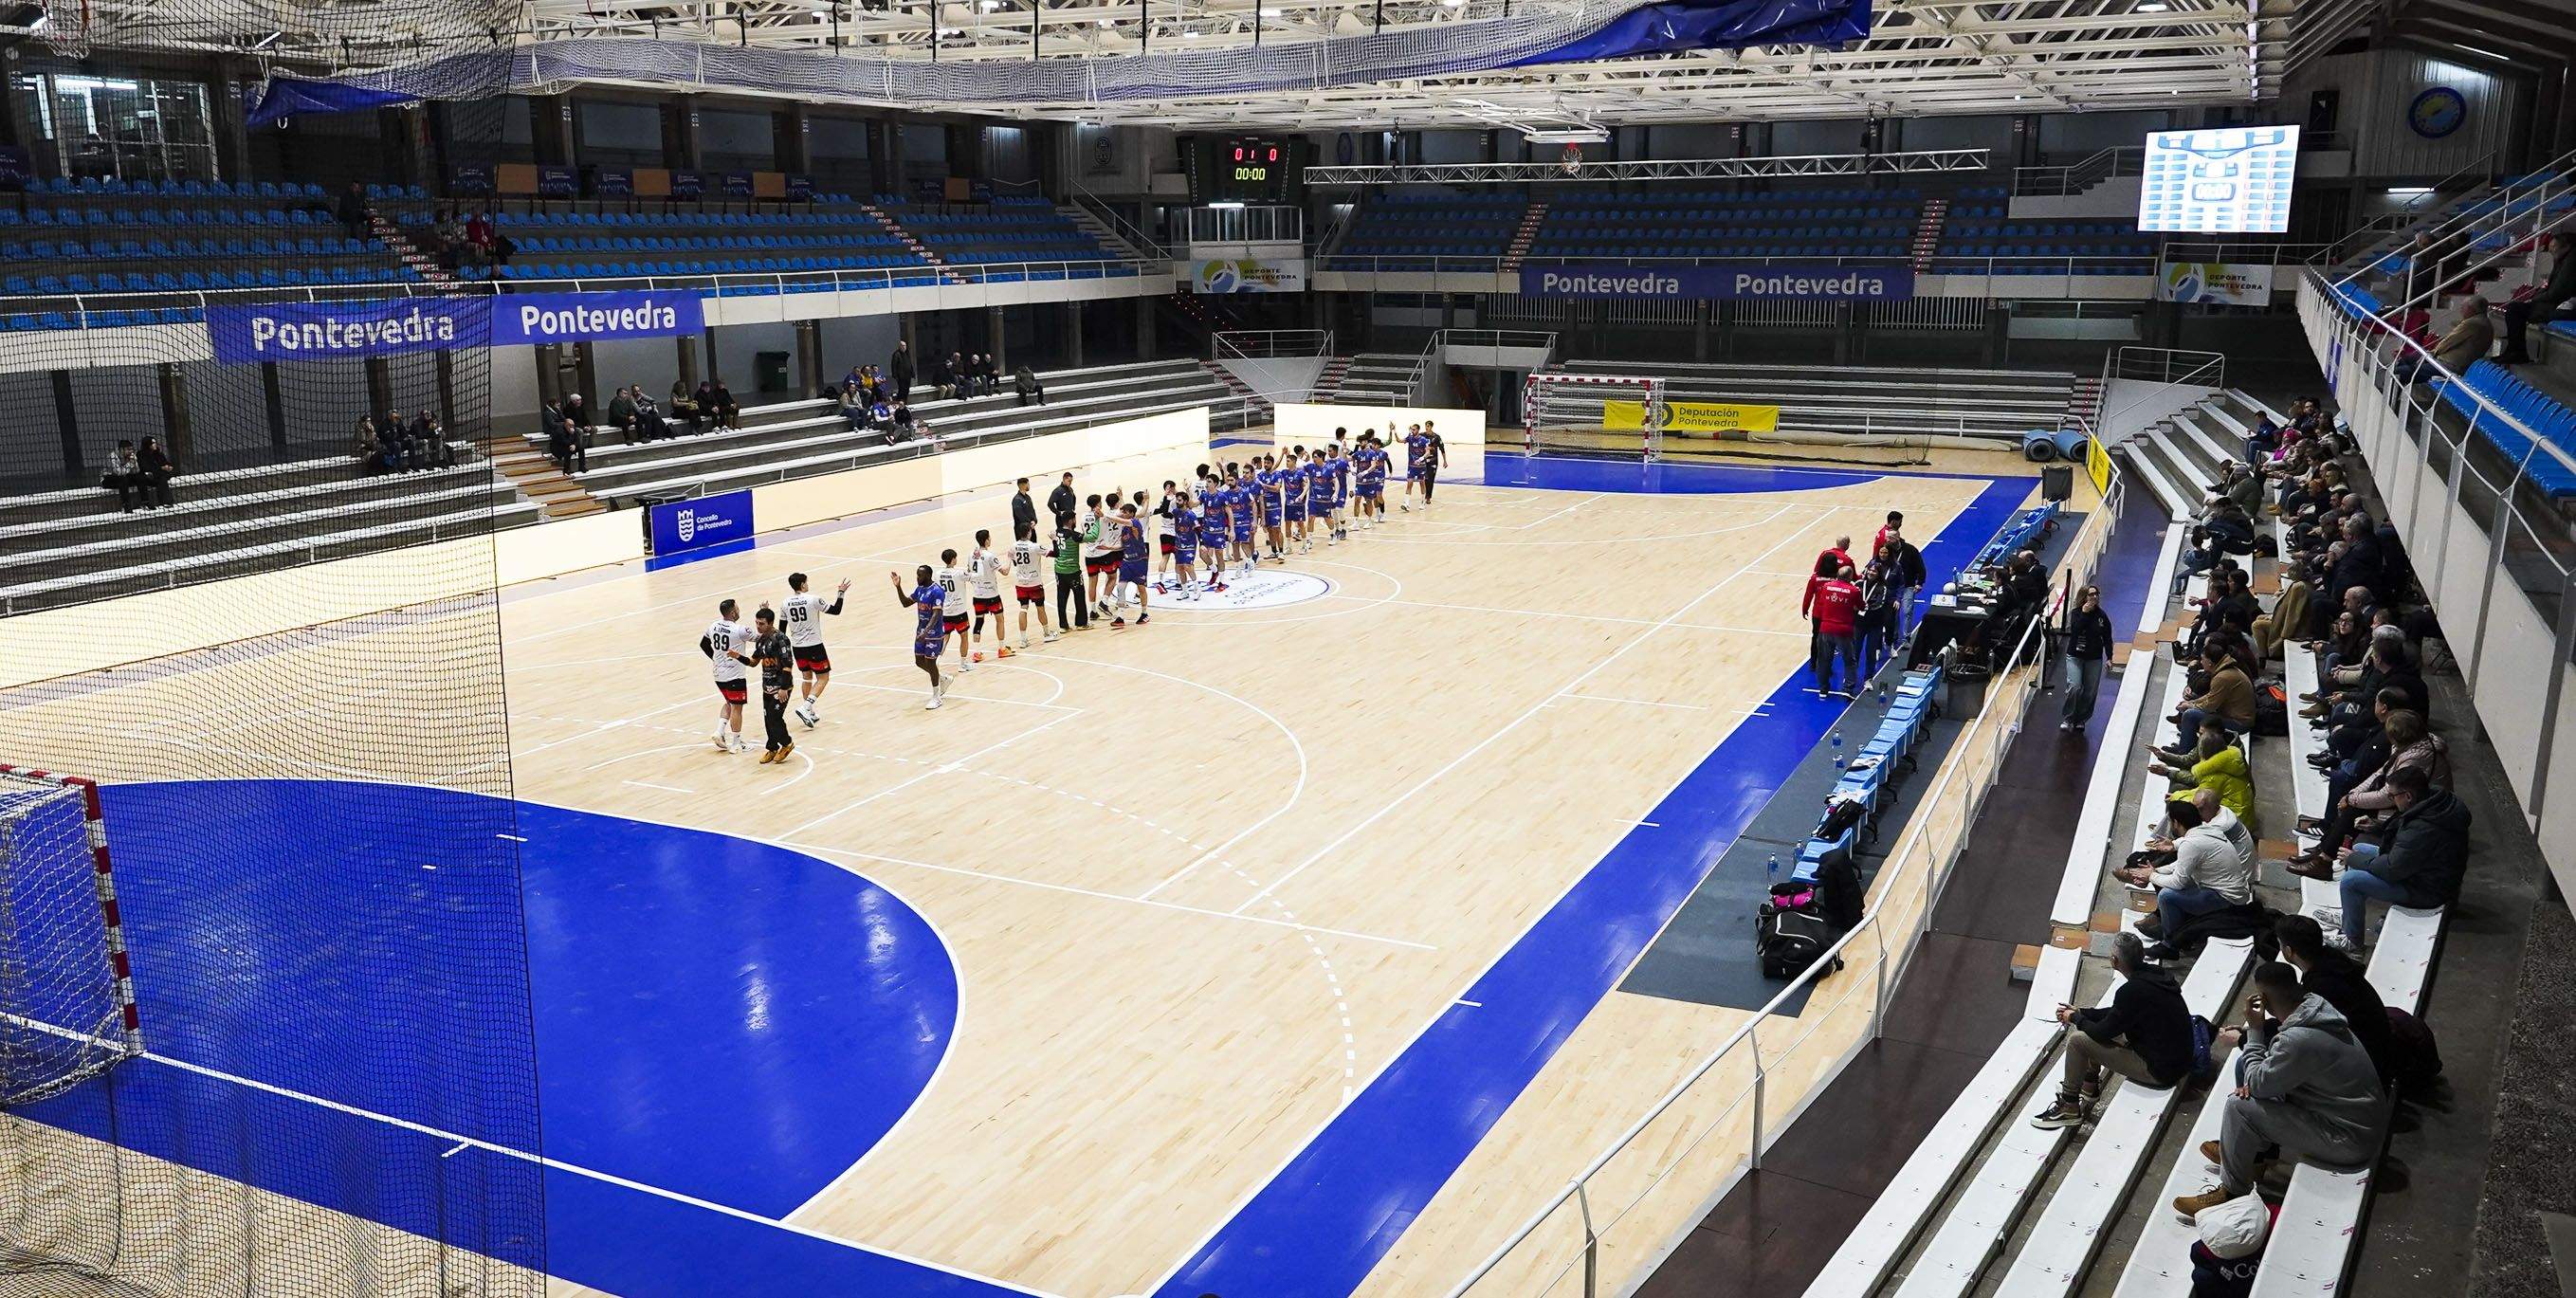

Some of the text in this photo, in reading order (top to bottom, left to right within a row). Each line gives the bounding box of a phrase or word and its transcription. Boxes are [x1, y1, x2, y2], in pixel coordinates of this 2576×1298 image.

[1235, 148, 1242, 160] 0
[1270, 148, 1277, 160] 0
[1235, 168, 1266, 180] 00:00
[1543, 272, 1679, 294] Pontevedra
[1734, 273, 1883, 296] Pontevedra
[2208, 282, 2263, 290] PONTEVEDRA
[521, 299, 676, 336] Pontevedra
[251, 306, 454, 352] Pontevedra
[1679, 407, 1740, 418] Deputación
[1678, 417, 1739, 428] Pontevedra
[697, 515, 718, 523] Concello
[704, 520, 732, 529] Pontevedra
[1015, 551, 1031, 565] 28
[939, 579, 956, 593] 50
[789, 606, 808, 623] 99
[713, 632, 730, 651] 89
[2233, 1260, 2259, 1279] Co
